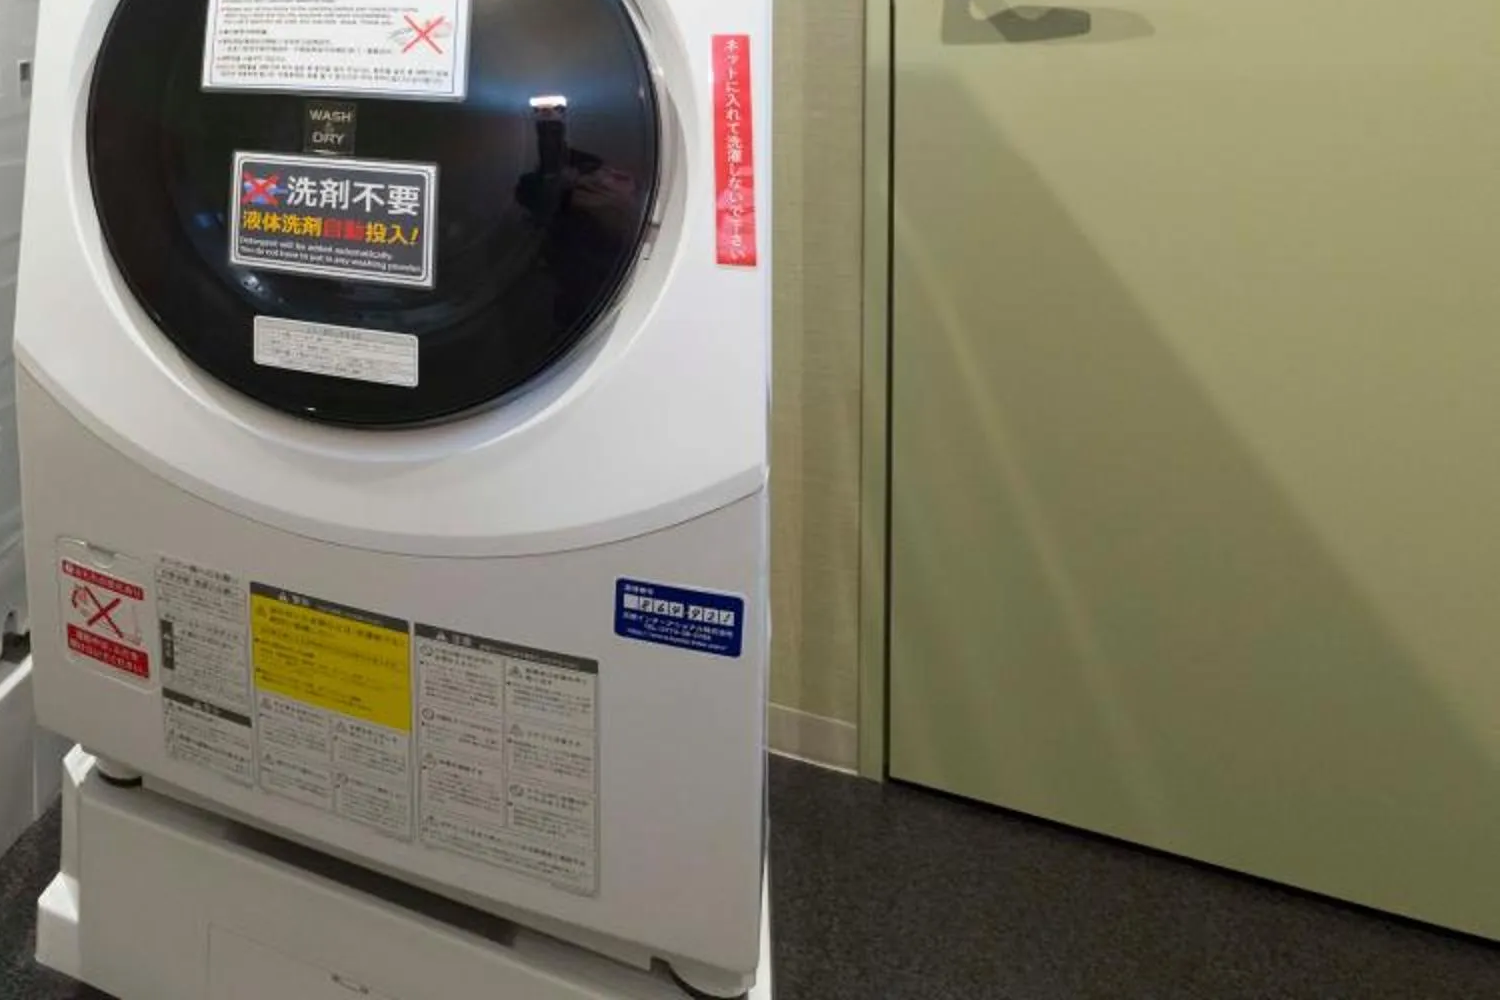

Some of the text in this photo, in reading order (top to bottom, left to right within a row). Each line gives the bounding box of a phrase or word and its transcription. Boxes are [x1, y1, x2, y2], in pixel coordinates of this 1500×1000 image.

[308, 108, 352, 124] WASH
[311, 130, 346, 145] DRY
[286, 175, 422, 217] 洗剤不要
